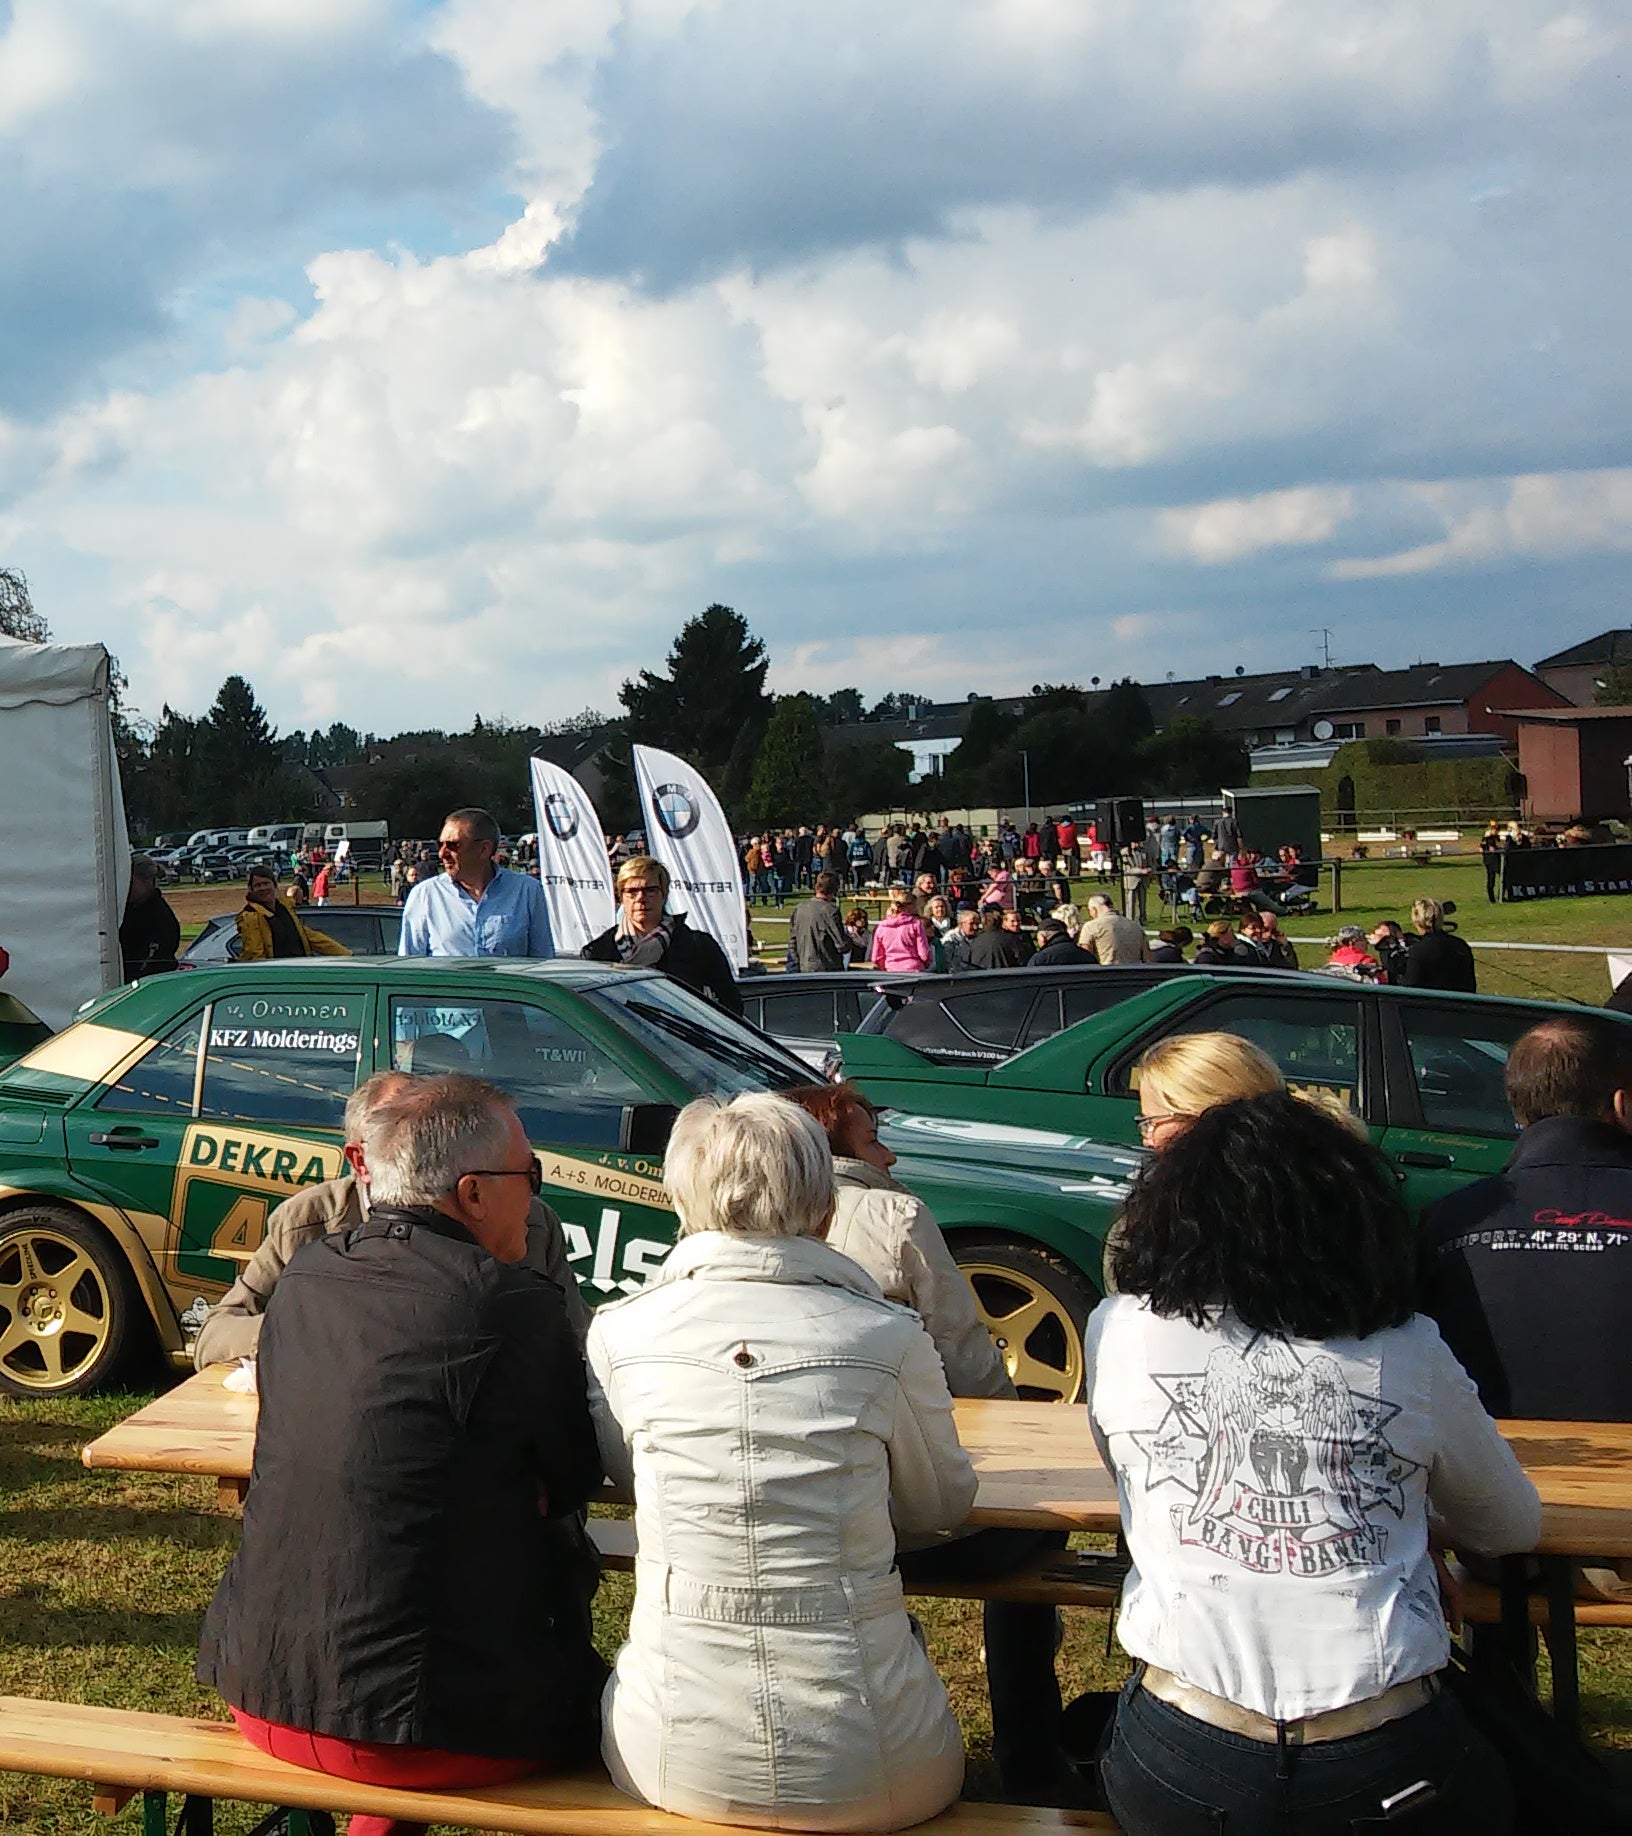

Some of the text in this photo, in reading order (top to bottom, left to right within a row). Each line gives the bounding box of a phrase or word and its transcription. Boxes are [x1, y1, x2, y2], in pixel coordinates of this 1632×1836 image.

[252, 999, 347, 1019] Ommen
[209, 1029, 358, 1054] KFZ Molderings
[189, 1133, 325, 1186] DEKRA
[598, 1154, 664, 1178] J. v. Om
[550, 1164, 673, 1206] A.+S. MOLDERIN
[561, 1208, 673, 1296] els
[1491, 1242, 1604, 1252] NORTH ATLANTIC OCEAN
[1246, 1496, 1313, 1526] CHILI
[1201, 1515, 1368, 1574] BANG BANG
